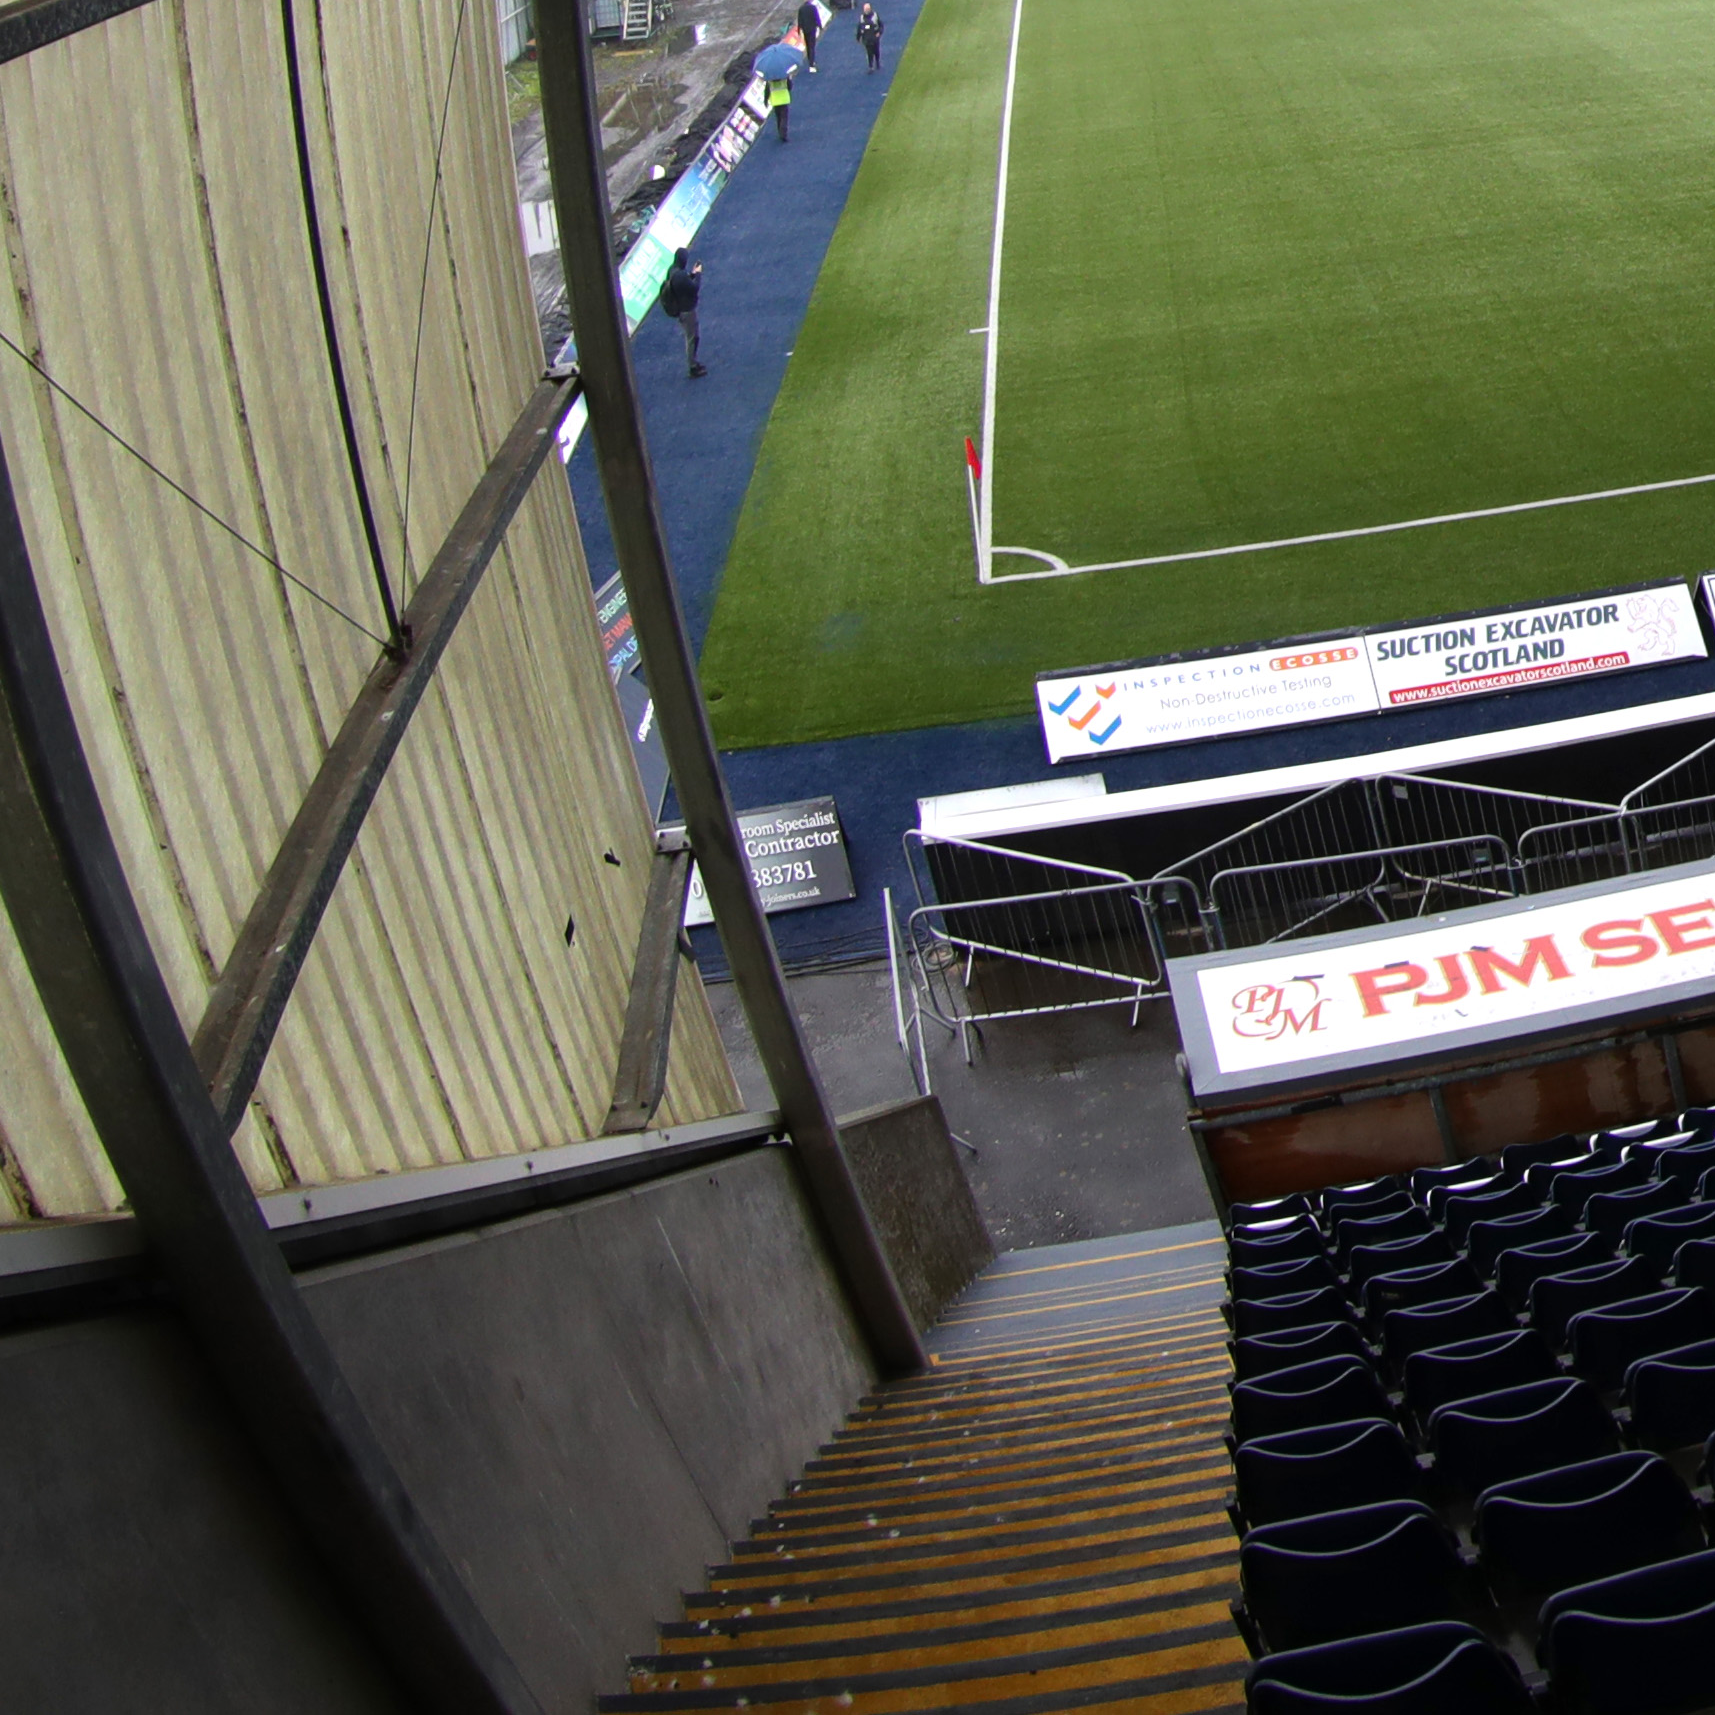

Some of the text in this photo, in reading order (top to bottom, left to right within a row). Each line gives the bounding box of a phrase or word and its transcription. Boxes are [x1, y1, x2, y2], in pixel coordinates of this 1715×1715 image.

[1376, 602, 1621, 662] SUCTION EXCAVATOR
[1122, 647, 1357, 693] INSPECTION ECOSSE
[1444, 637, 1566, 677] SCOTLAND
[1160, 673, 1333, 711] Non-Destructive Testing
[1392, 653, 1627, 704] www.suctionexcavatorscotland.com
[1145, 691, 1357, 735] www.inspectionecosse.com
[742, 811, 836, 839] room Specialist
[745, 830, 840, 858] Contractor
[752, 860, 817, 888] 383781
[1348, 933, 1574, 1017] PJM
